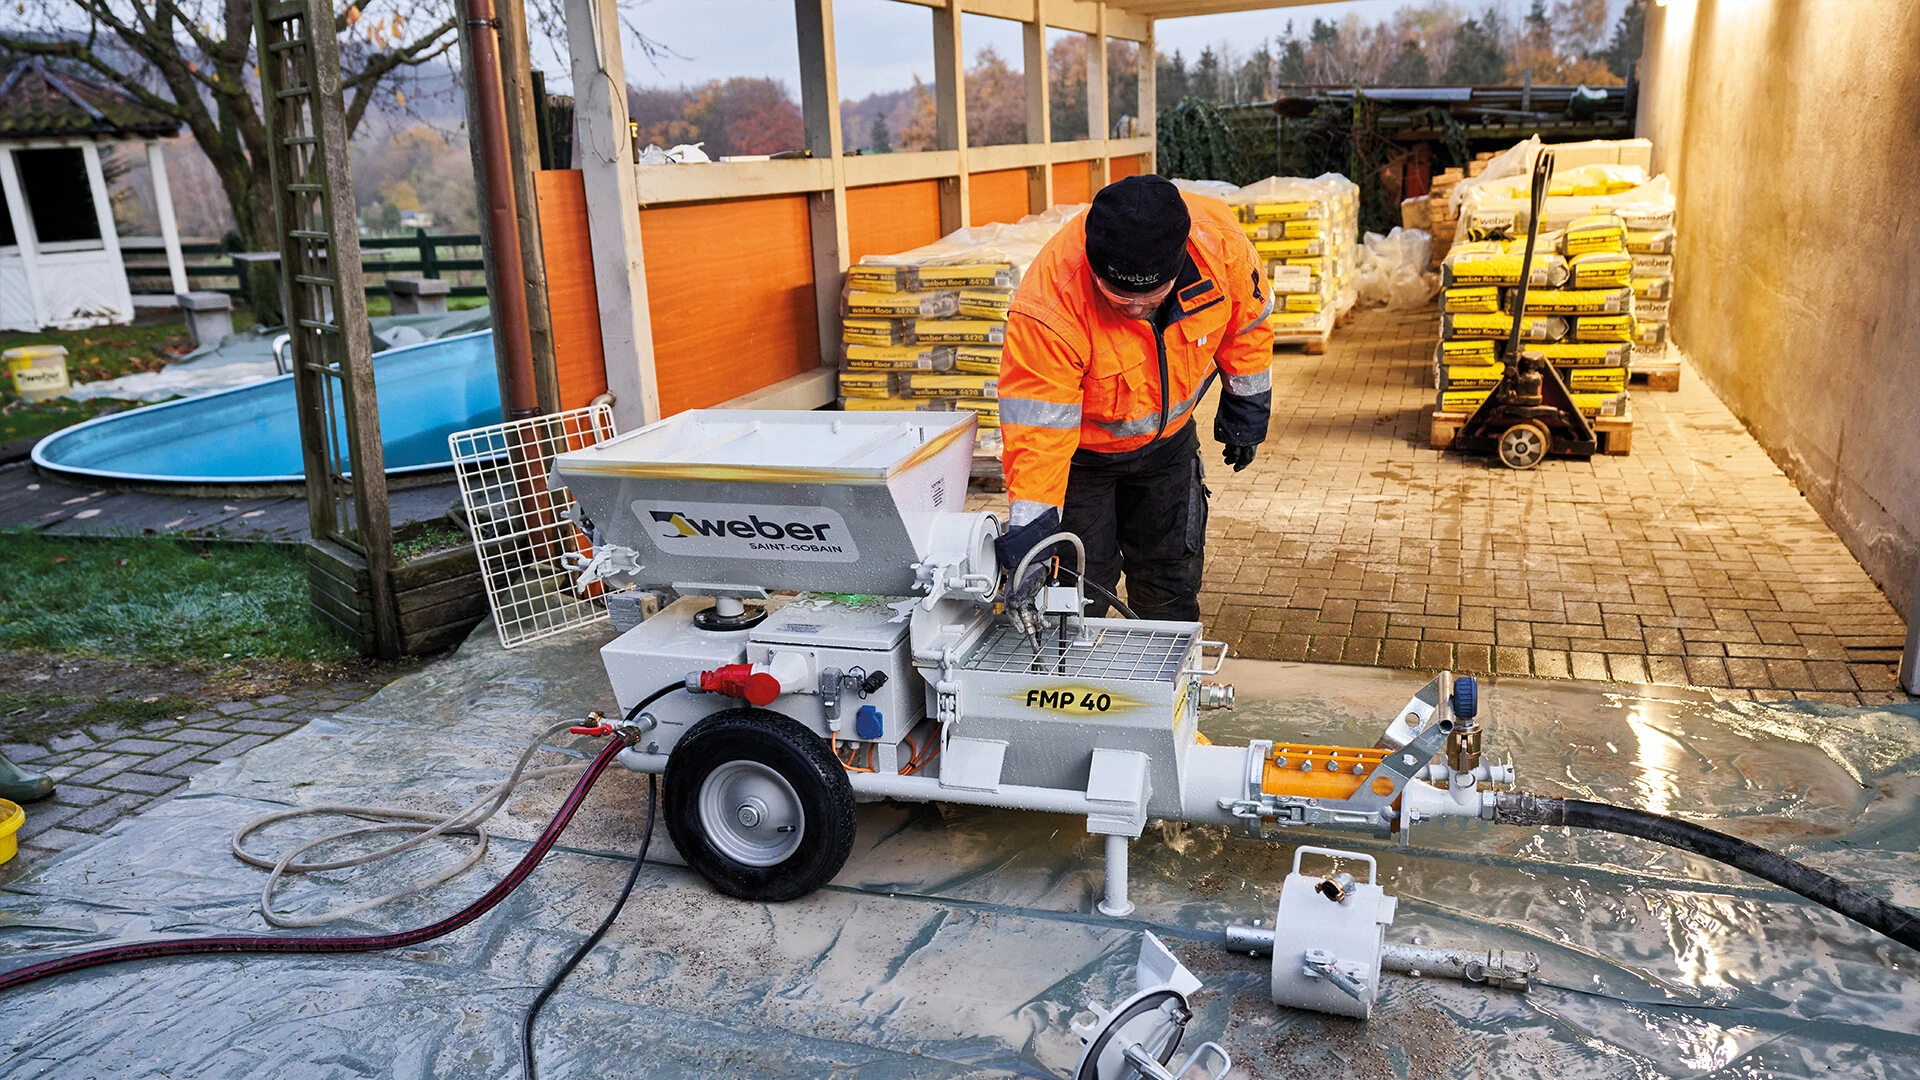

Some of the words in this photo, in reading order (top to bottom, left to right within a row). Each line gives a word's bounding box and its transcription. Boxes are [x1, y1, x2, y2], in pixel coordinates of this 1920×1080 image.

[1480, 216, 1512, 226] weber
[1635, 258, 1670, 267] weber
[1117, 272, 1159, 282] weber
[1456, 276, 1482, 284] weber
[1483, 276, 1502, 284] floor
[923, 279, 947, 287] weber
[852, 306, 874, 315] weber
[875, 306, 893, 314] floor
[895, 306, 916, 314] 4470
[1527, 304, 1553, 312] weber
[1554, 304, 1574, 312] floor
[1634, 301, 1666, 312] weber
[1456, 328, 1482, 336] weber
[1482, 328, 1503, 336] floor
[919, 334, 943, 342] weber
[963, 334, 984, 342] 4470
[850, 360, 873, 368] weber
[873, 360, 891, 368] floor
[893, 361, 914, 369] 4470
[1555, 357, 1575, 365] floor
[1578, 357, 1600, 365] 4470
[1452, 379, 1478, 387] weber
[1478, 379, 1498, 387] floor
[914, 388, 938, 396] weber
[684, 514, 831, 542] weber
[748, 542, 843, 554] SAINT-GOBAIN
[1026, 689, 1075, 709] FMP
[1080, 693, 1111, 712] 40
